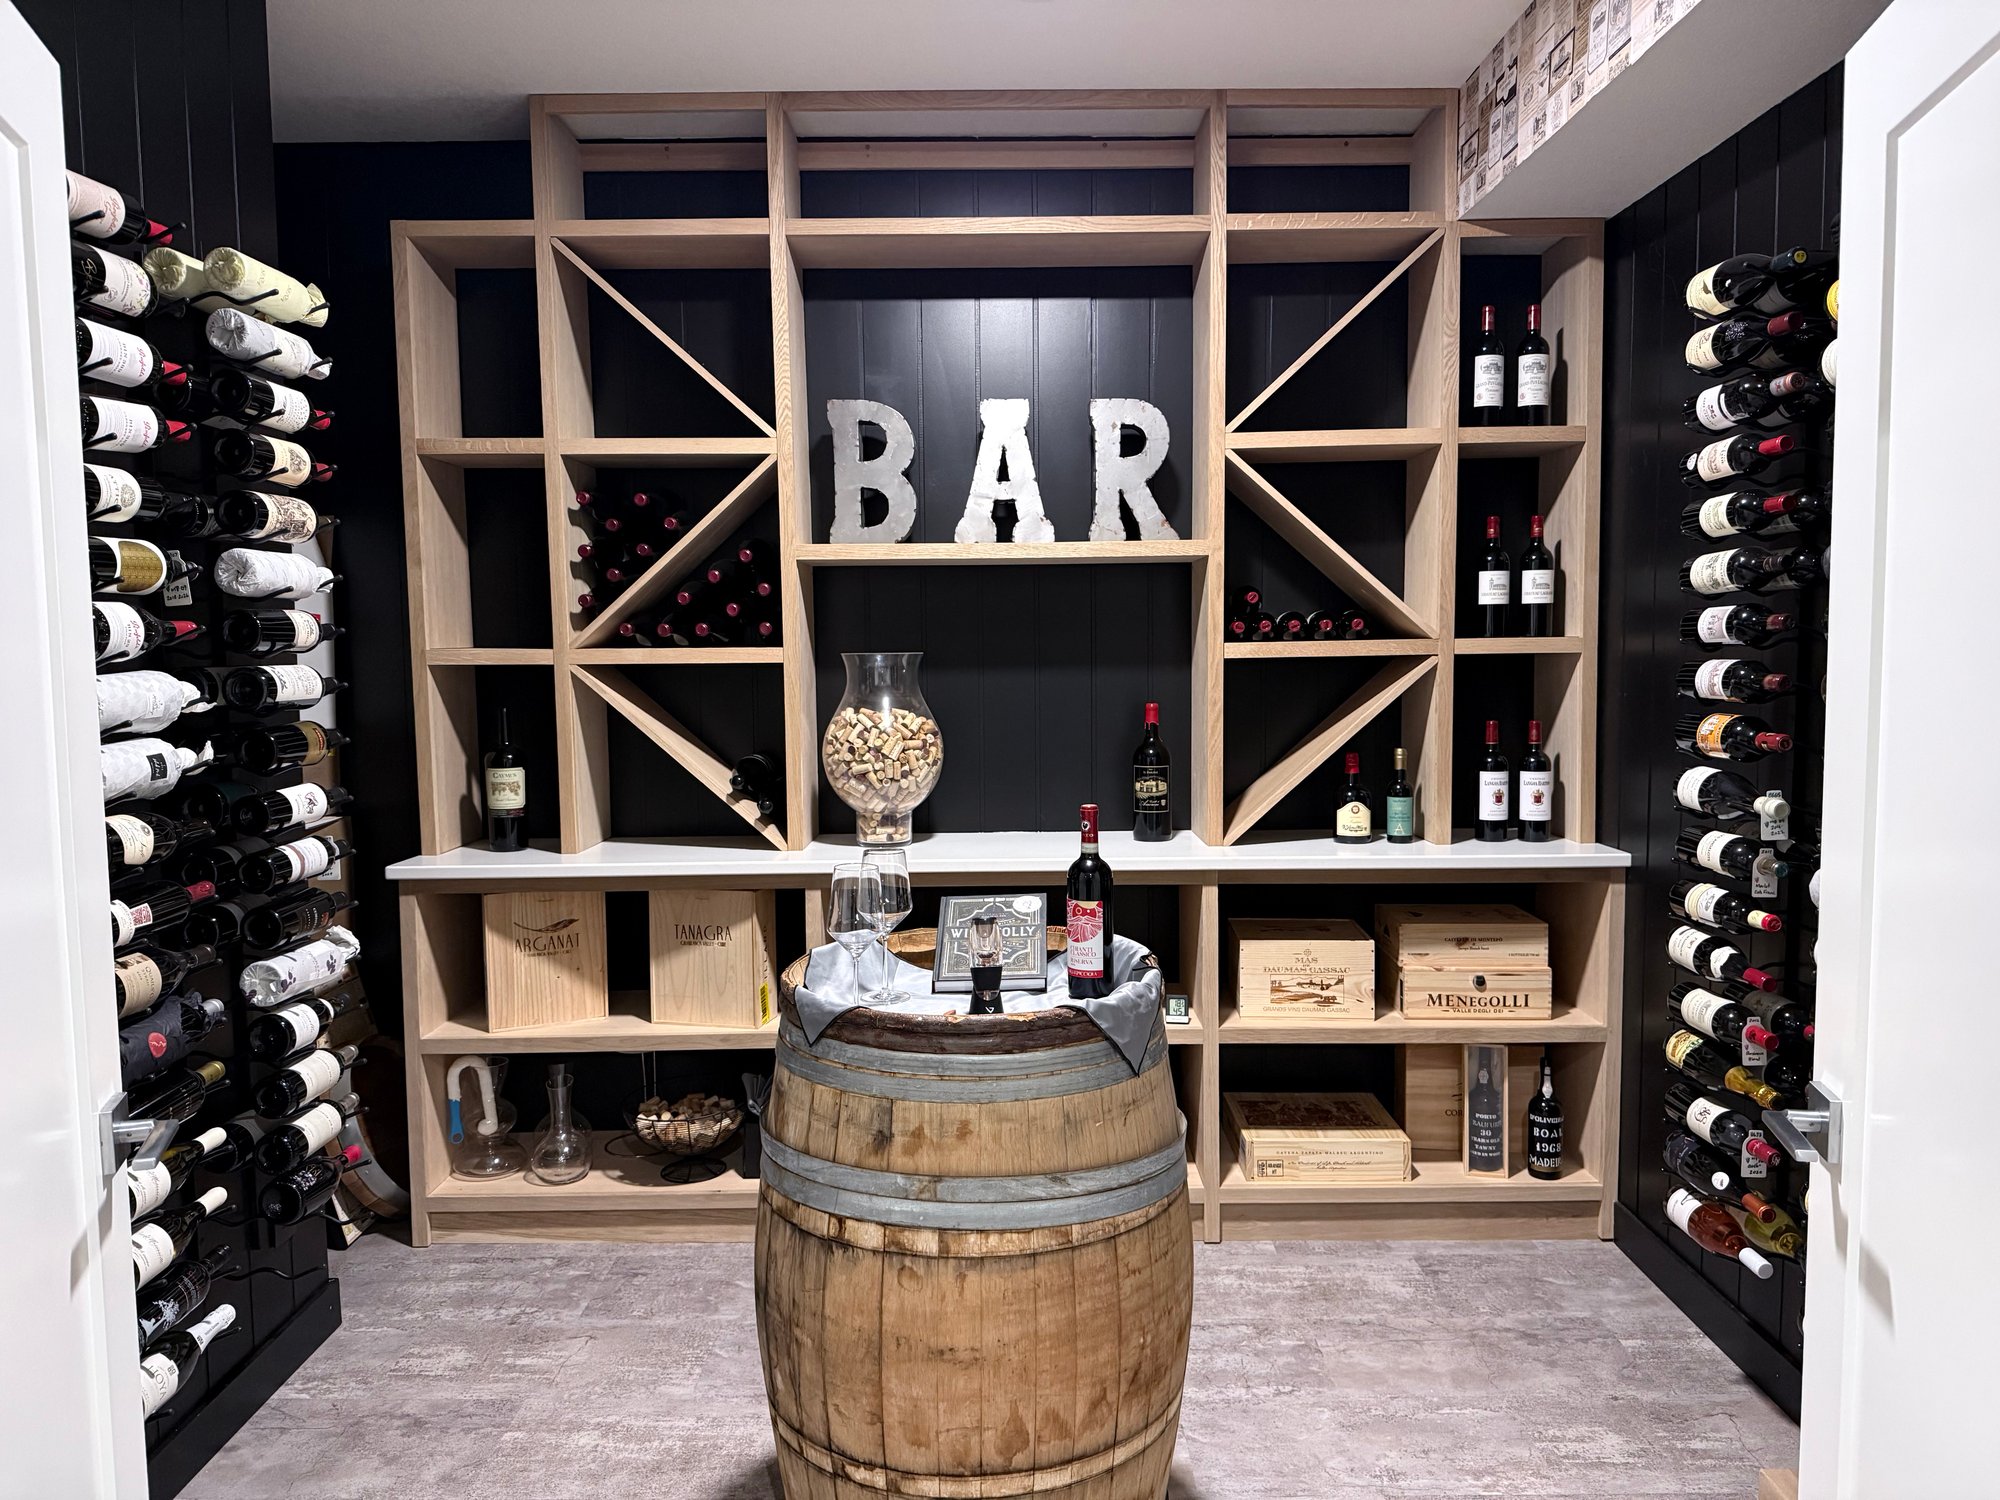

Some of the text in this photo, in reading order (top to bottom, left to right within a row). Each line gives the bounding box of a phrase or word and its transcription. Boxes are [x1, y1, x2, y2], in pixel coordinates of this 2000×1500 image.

[827, 398, 1181, 543] BAR
[674, 924, 732, 941] TANAGRA
[1426, 993, 1530, 1008] MENEGOLLI
[1535, 1141, 1561, 1152] 1968
